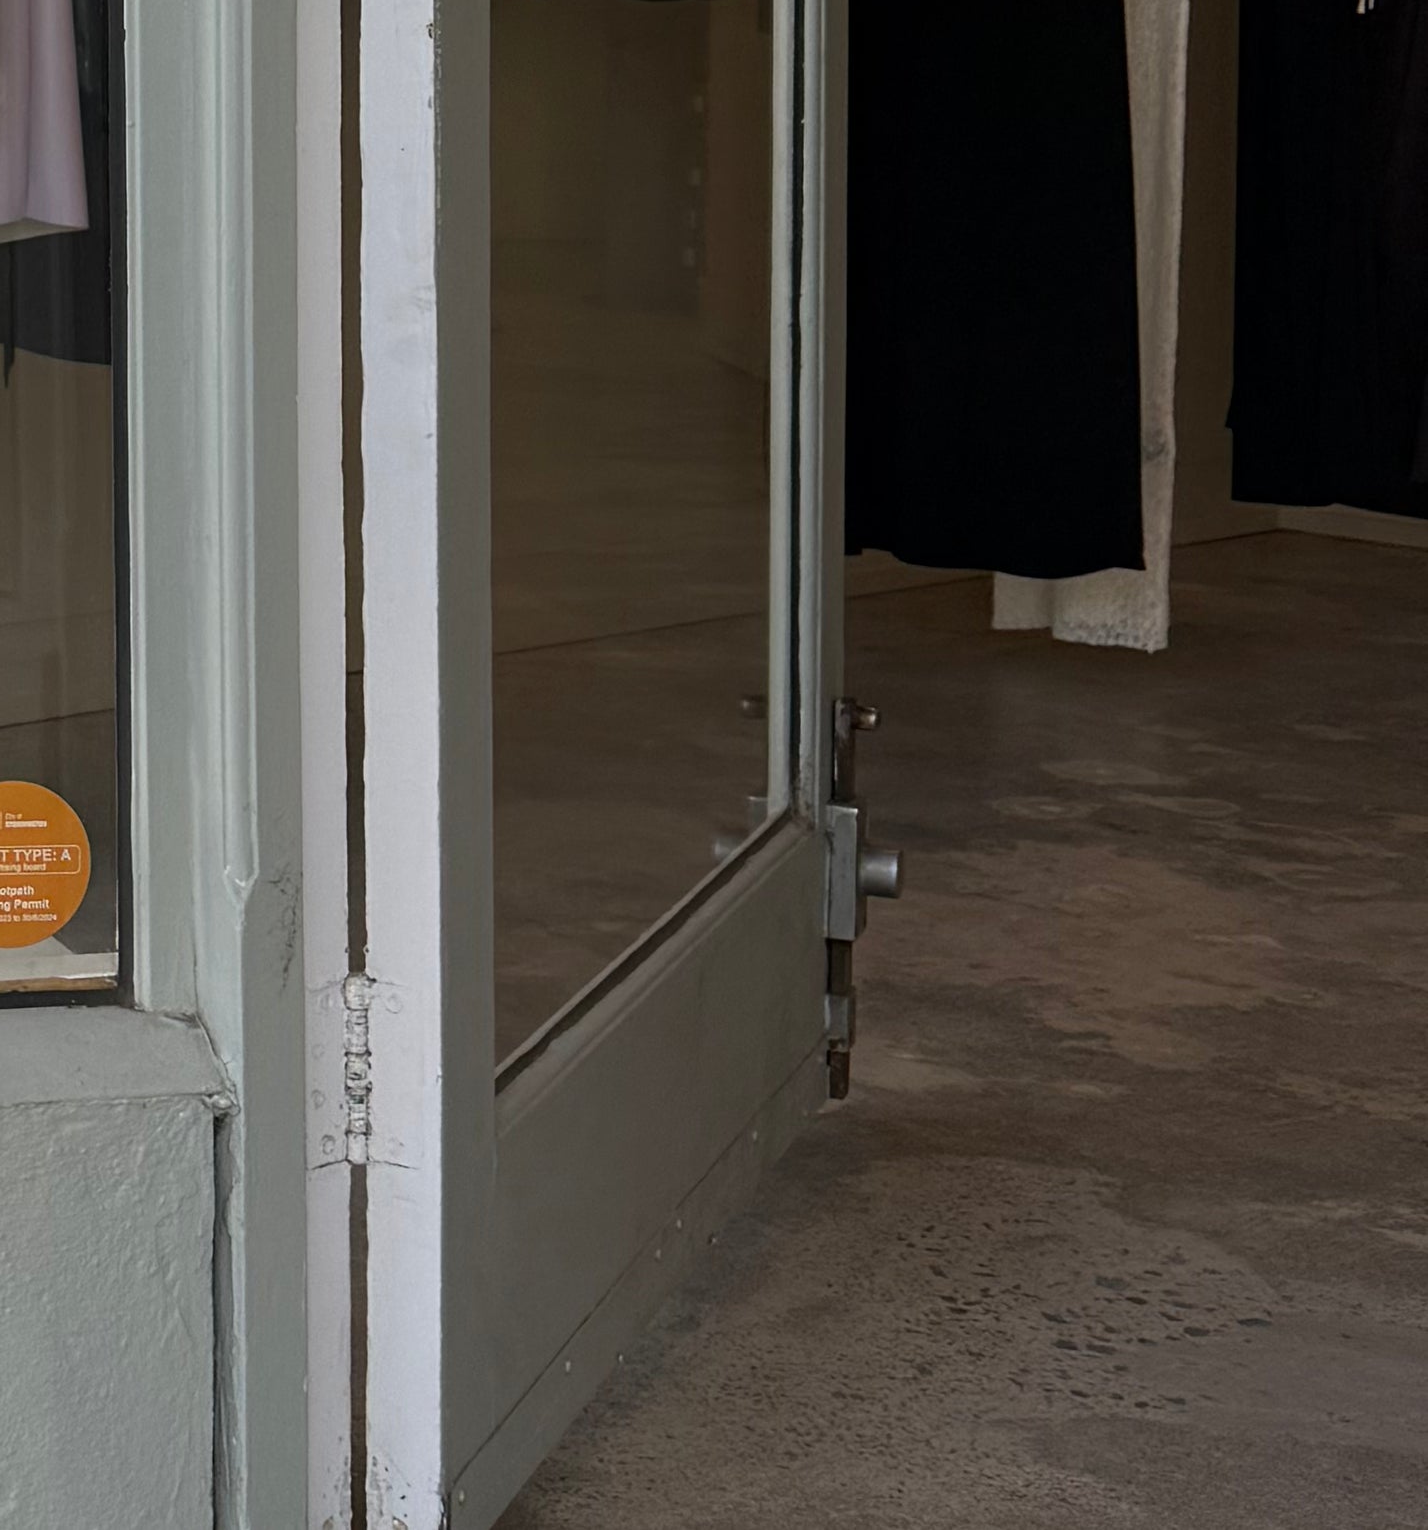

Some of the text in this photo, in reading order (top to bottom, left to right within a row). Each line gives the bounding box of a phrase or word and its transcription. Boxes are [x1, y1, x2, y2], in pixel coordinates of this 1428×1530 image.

[13, 848, 57, 861] TYPE:
[60, 848, 72, 861] A
[14, 899, 50, 909] Permit
